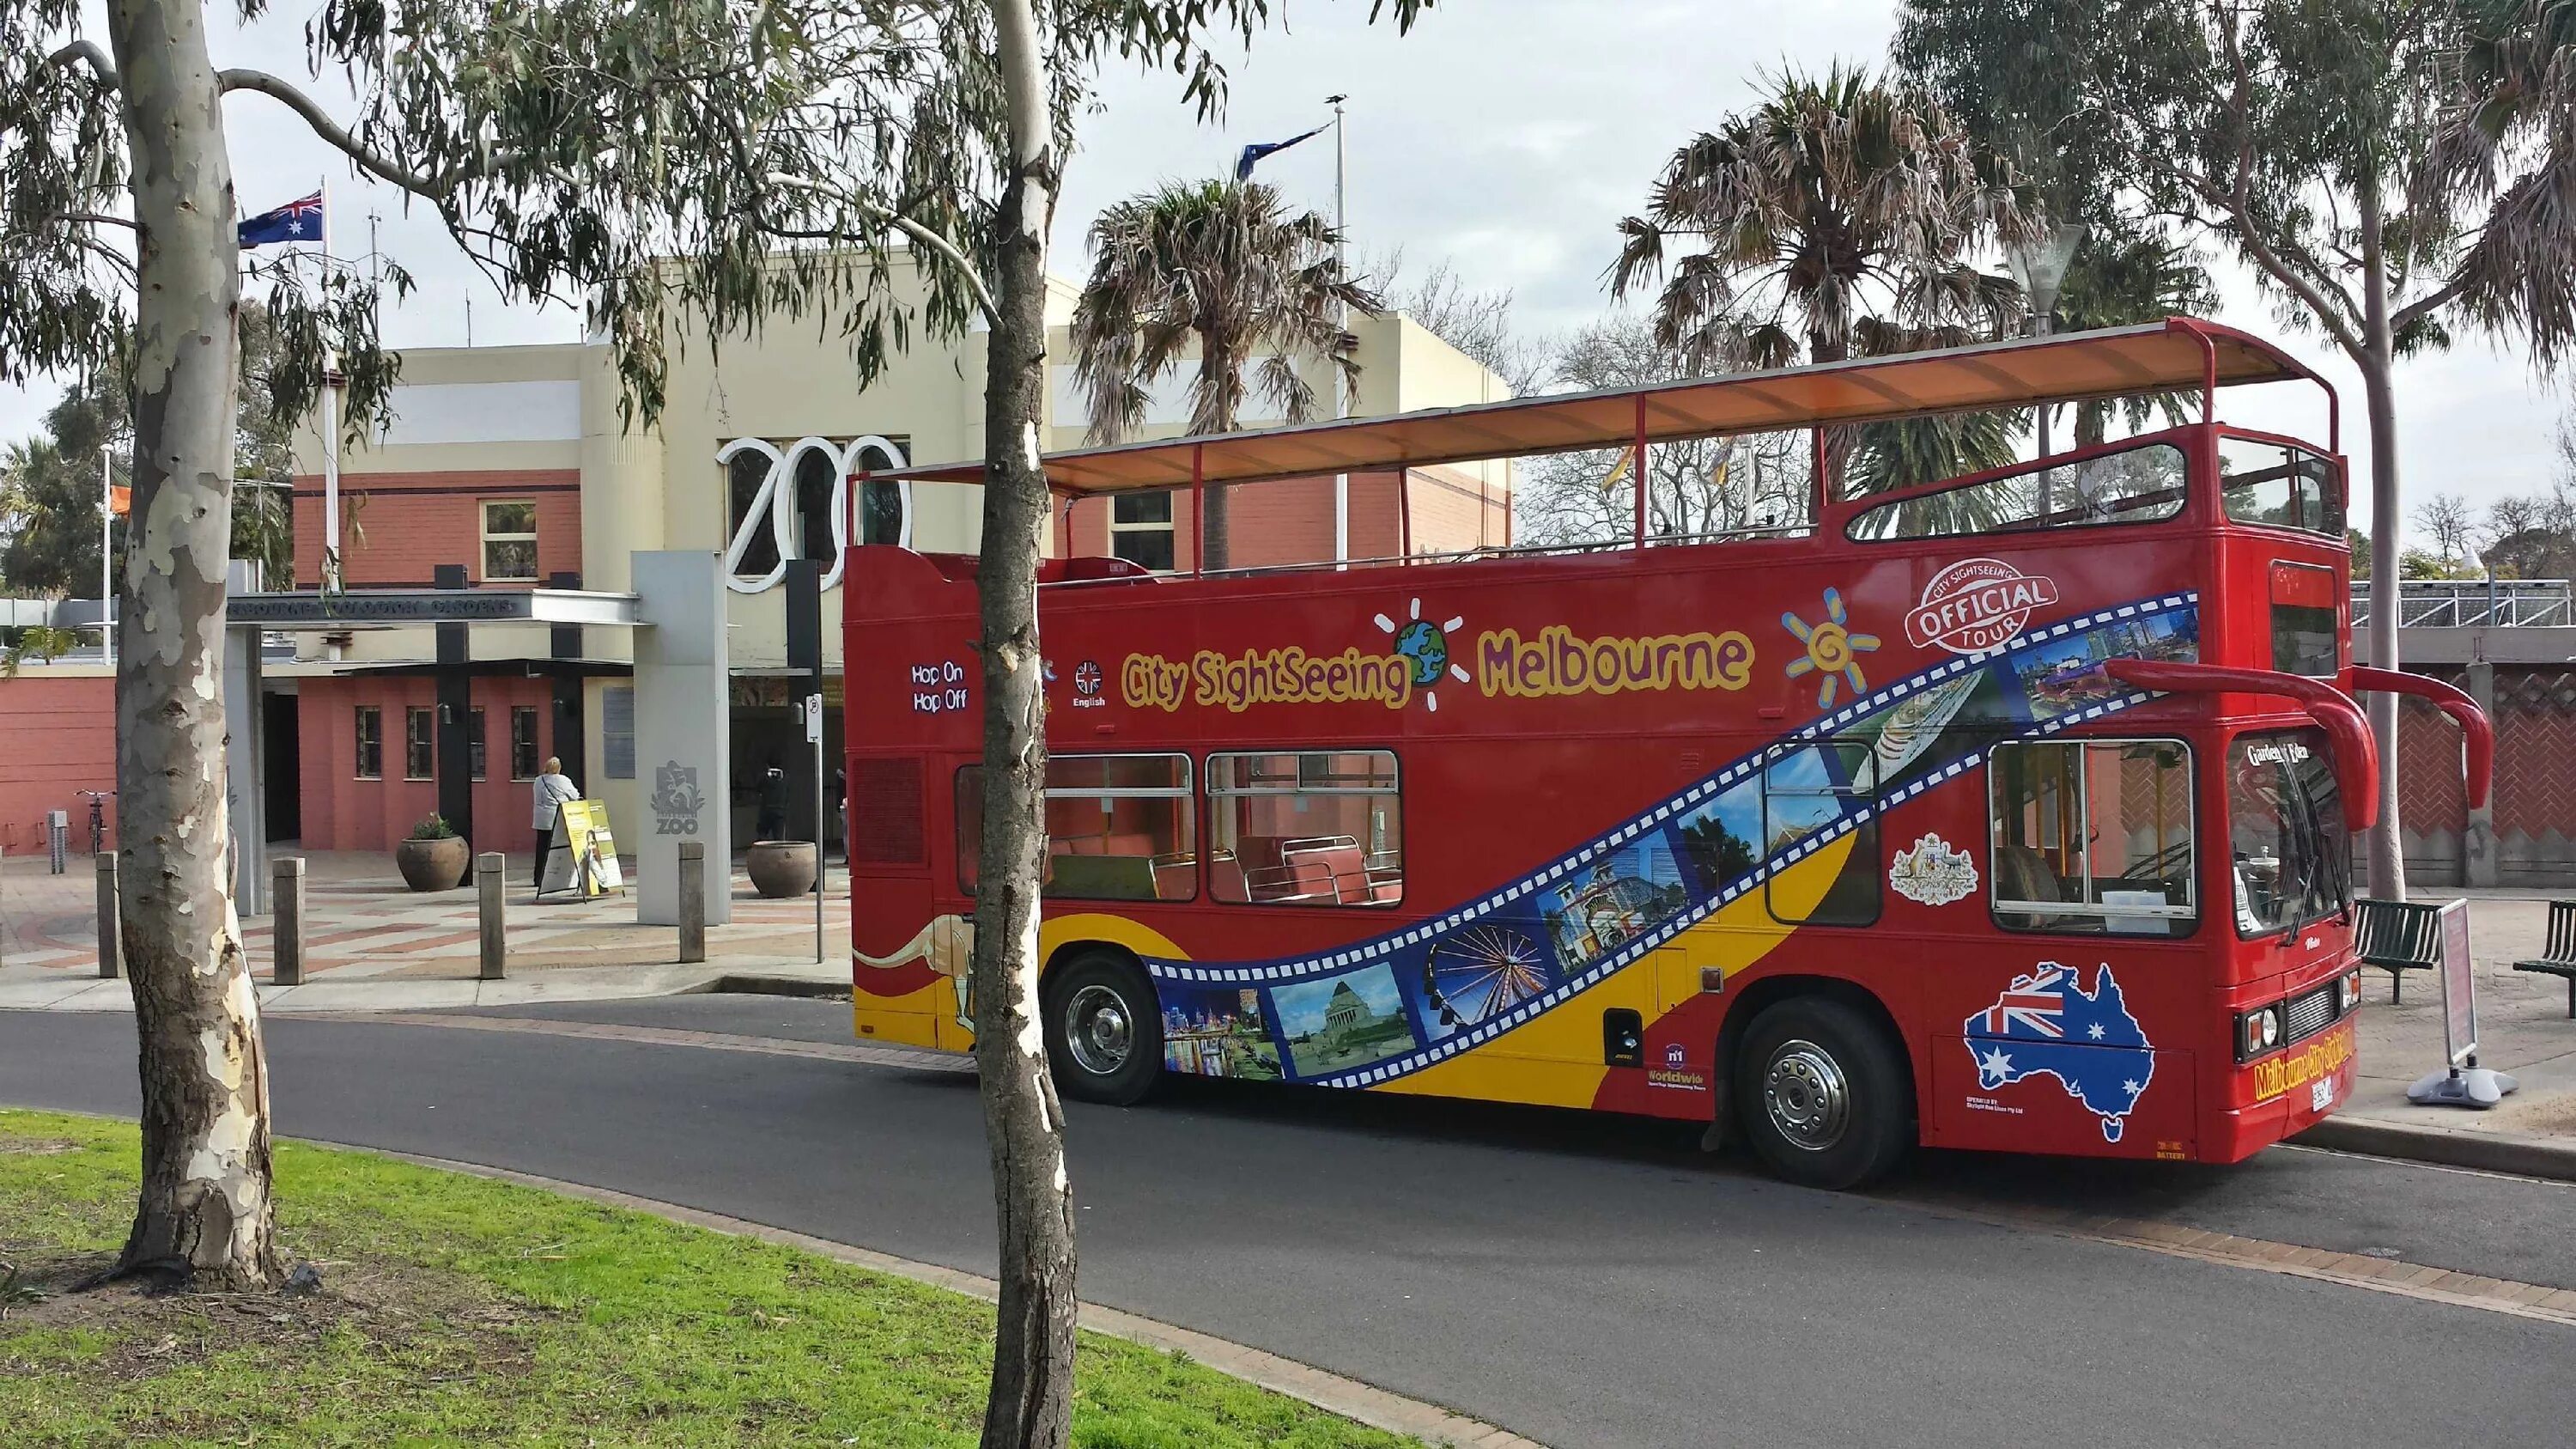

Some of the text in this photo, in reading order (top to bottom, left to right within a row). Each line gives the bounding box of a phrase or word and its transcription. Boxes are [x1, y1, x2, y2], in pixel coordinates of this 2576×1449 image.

[1933, 565, 2013, 599] CITY SIGHTSEEING
[1919, 581, 2049, 636] OFFICIAL
[1962, 616, 2020, 647] TOUR
[912, 661, 963, 685] Hop On
[1122, 624, 1755, 713] City SightSeeing Melbourne
[914, 689, 968, 713] Hop Off
[1072, 697, 1106, 708] English
[2247, 744, 2282, 766] Garden
[2287, 743, 2310, 764] Eden
[656, 818, 699, 835] ZOO
[2254, 1055, 2308, 1100] Melbourne
